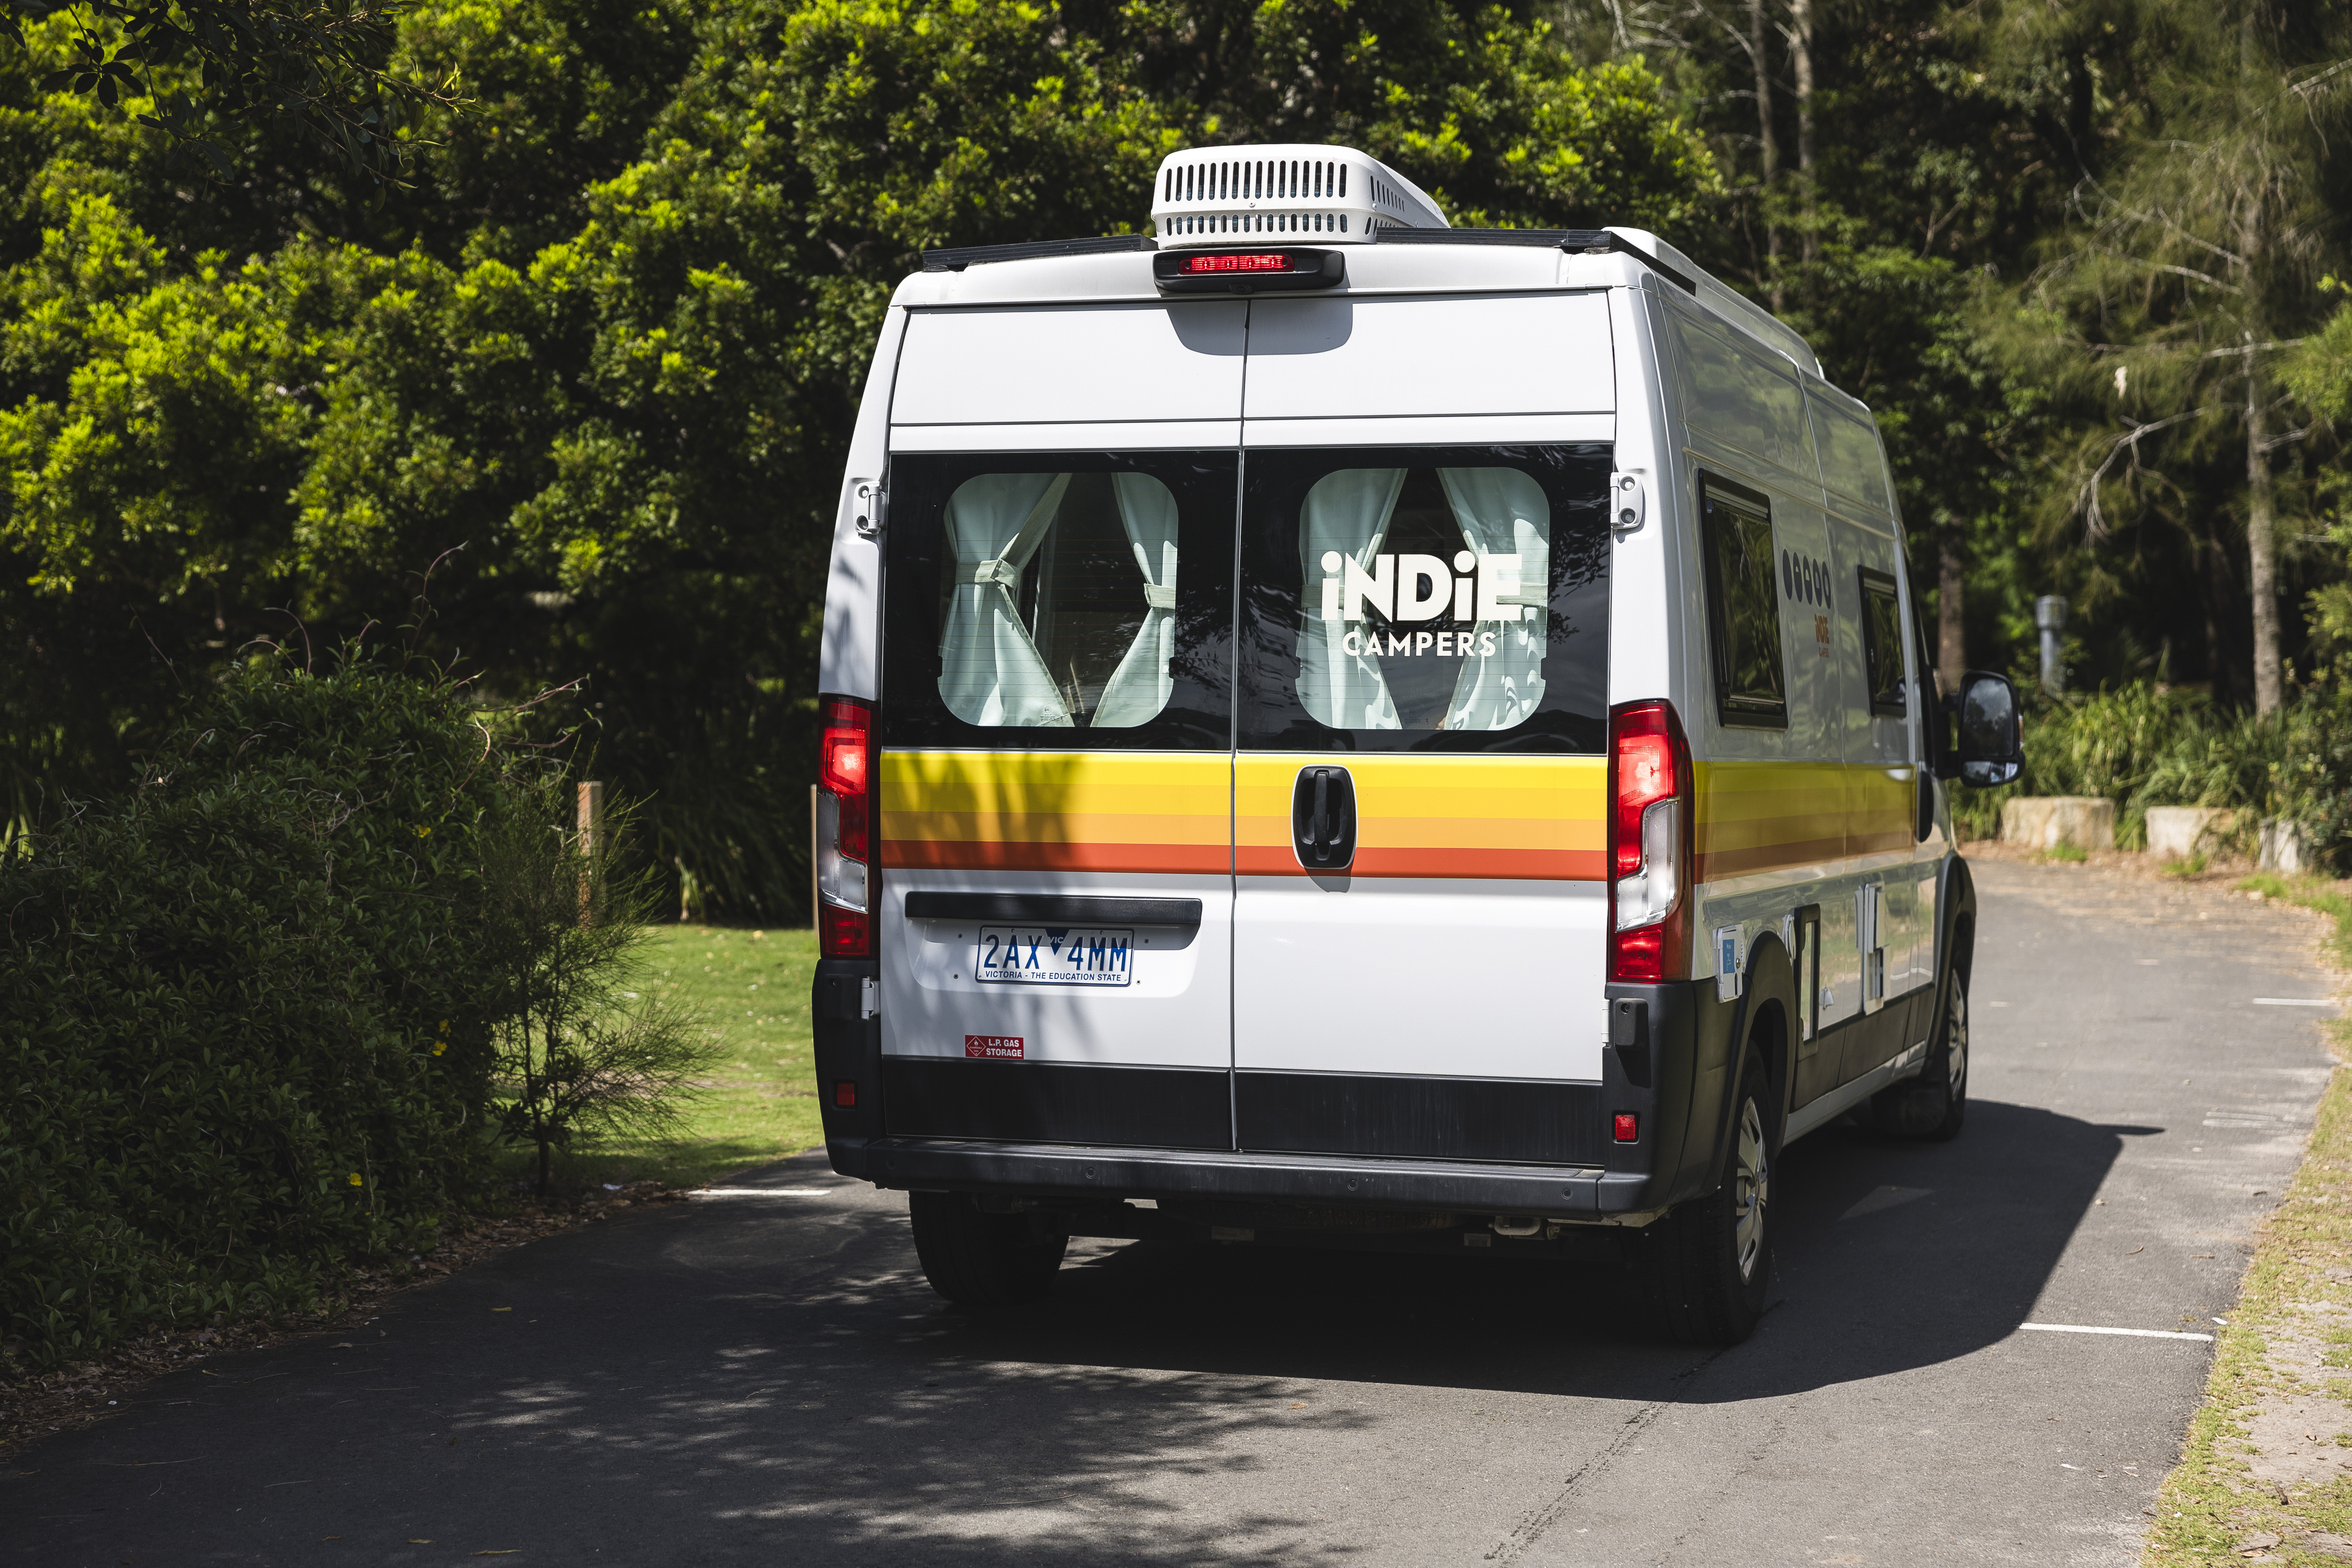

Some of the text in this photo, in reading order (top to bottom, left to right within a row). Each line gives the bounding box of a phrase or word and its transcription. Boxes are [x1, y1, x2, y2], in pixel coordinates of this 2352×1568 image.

[1321, 550, 1523, 622] iNDiE
[1342, 631, 1496, 657] CAMPERS
[984, 934, 1129, 972] 2AX 4MM
[1049, 972, 1095, 980] EDUCATION
[1004, 1039, 1019, 1047] GAS
[986, 1048, 1022, 1057] STORAGE
